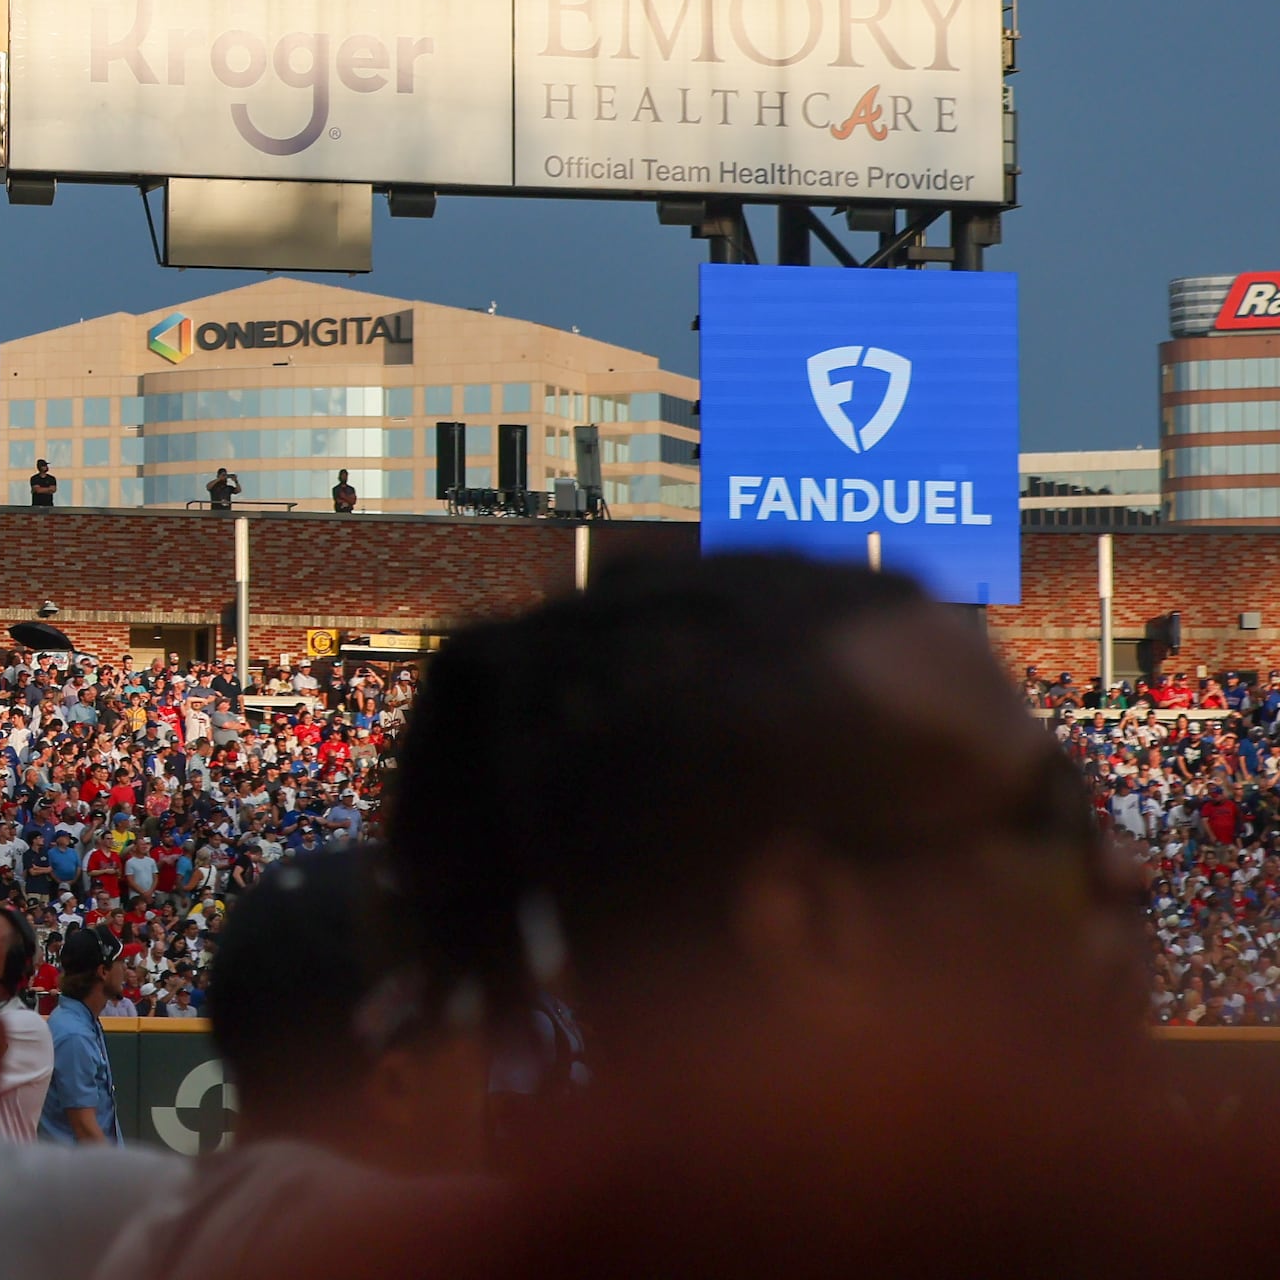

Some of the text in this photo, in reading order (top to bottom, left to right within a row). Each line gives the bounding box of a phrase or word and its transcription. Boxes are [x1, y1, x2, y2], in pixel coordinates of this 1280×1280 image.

[542, 82, 958, 141] HEALTHCARE
[544, 154, 975, 192] Official Team Healthcare Provider
[196, 315, 413, 351] ONEDIGITAL
[728, 476, 992, 526] FANDUEL
